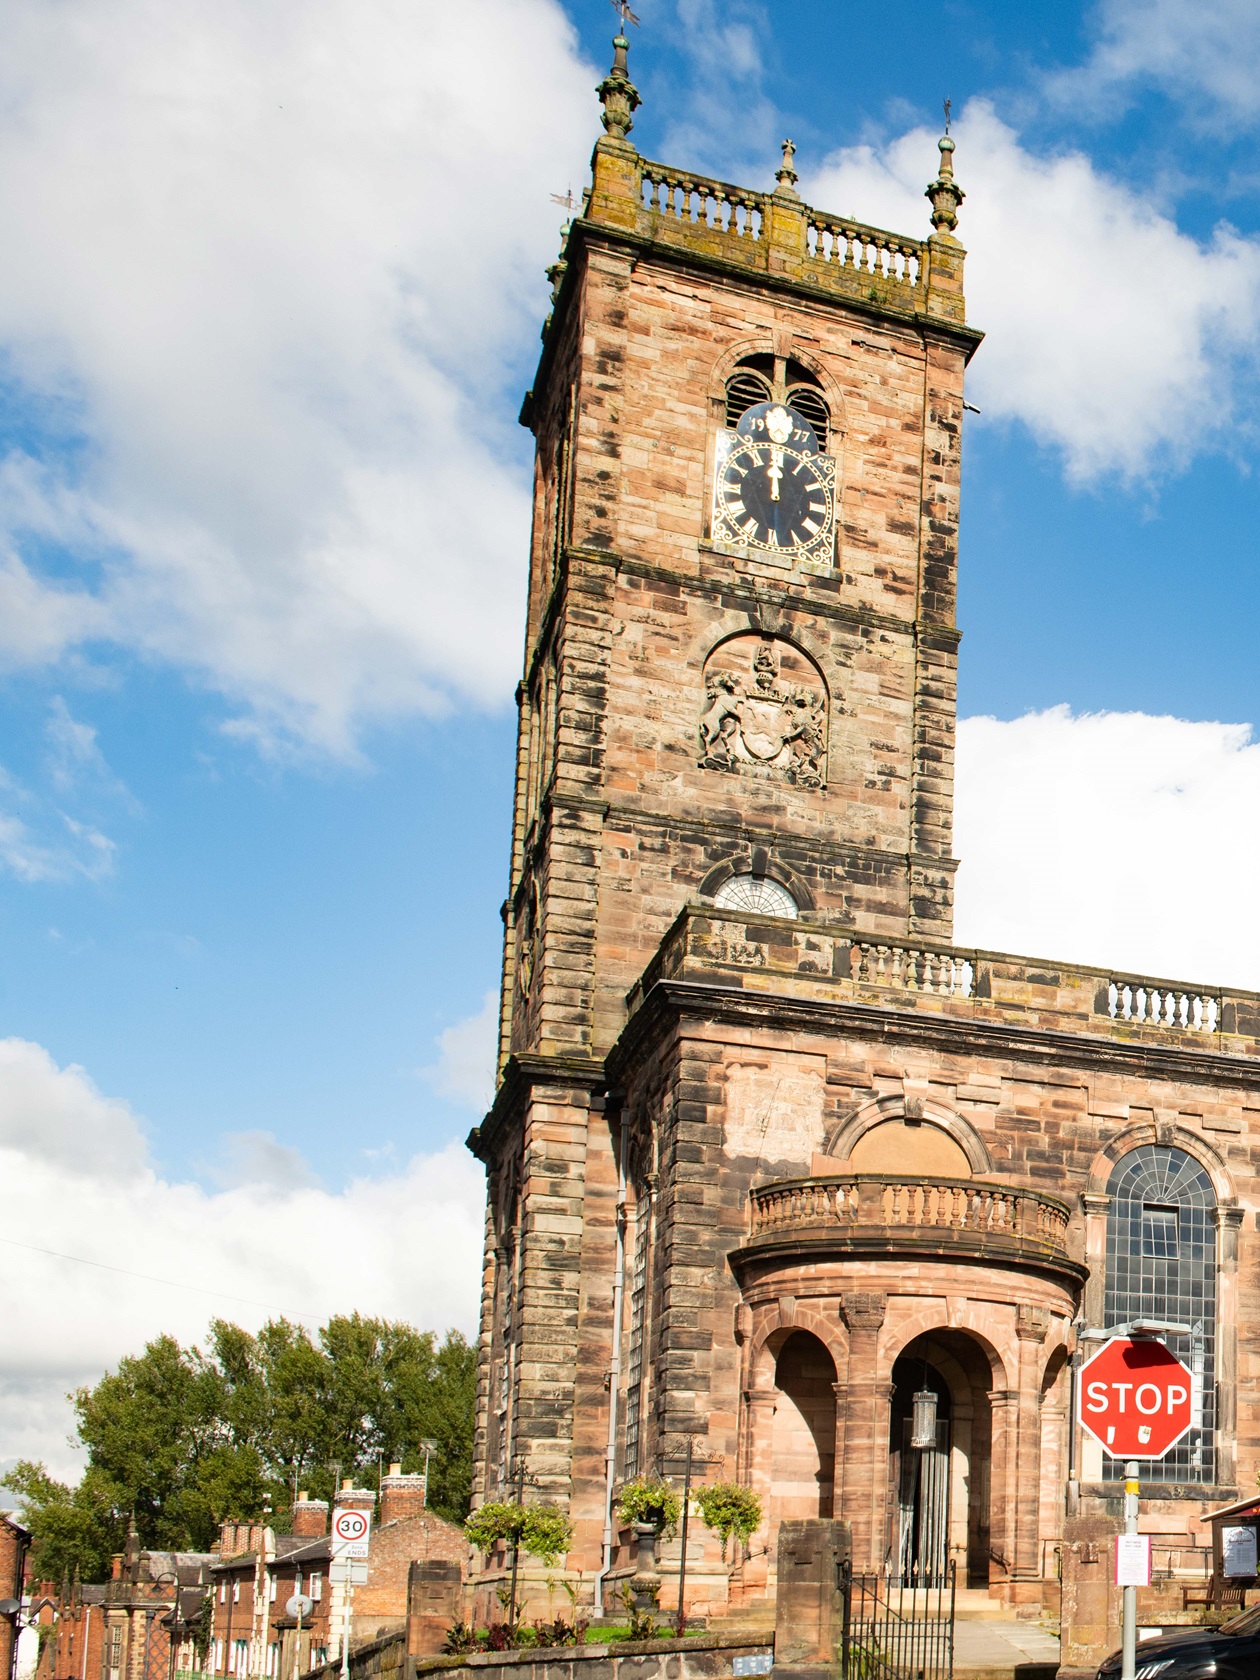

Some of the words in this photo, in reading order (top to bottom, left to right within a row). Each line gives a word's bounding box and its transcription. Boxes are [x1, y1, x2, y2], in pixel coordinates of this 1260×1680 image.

[750, 417, 765, 431] 19
[793, 428, 810, 442] 77
[1086, 1381, 1188, 1415] STOP
[341, 1520, 363, 1532] 30
